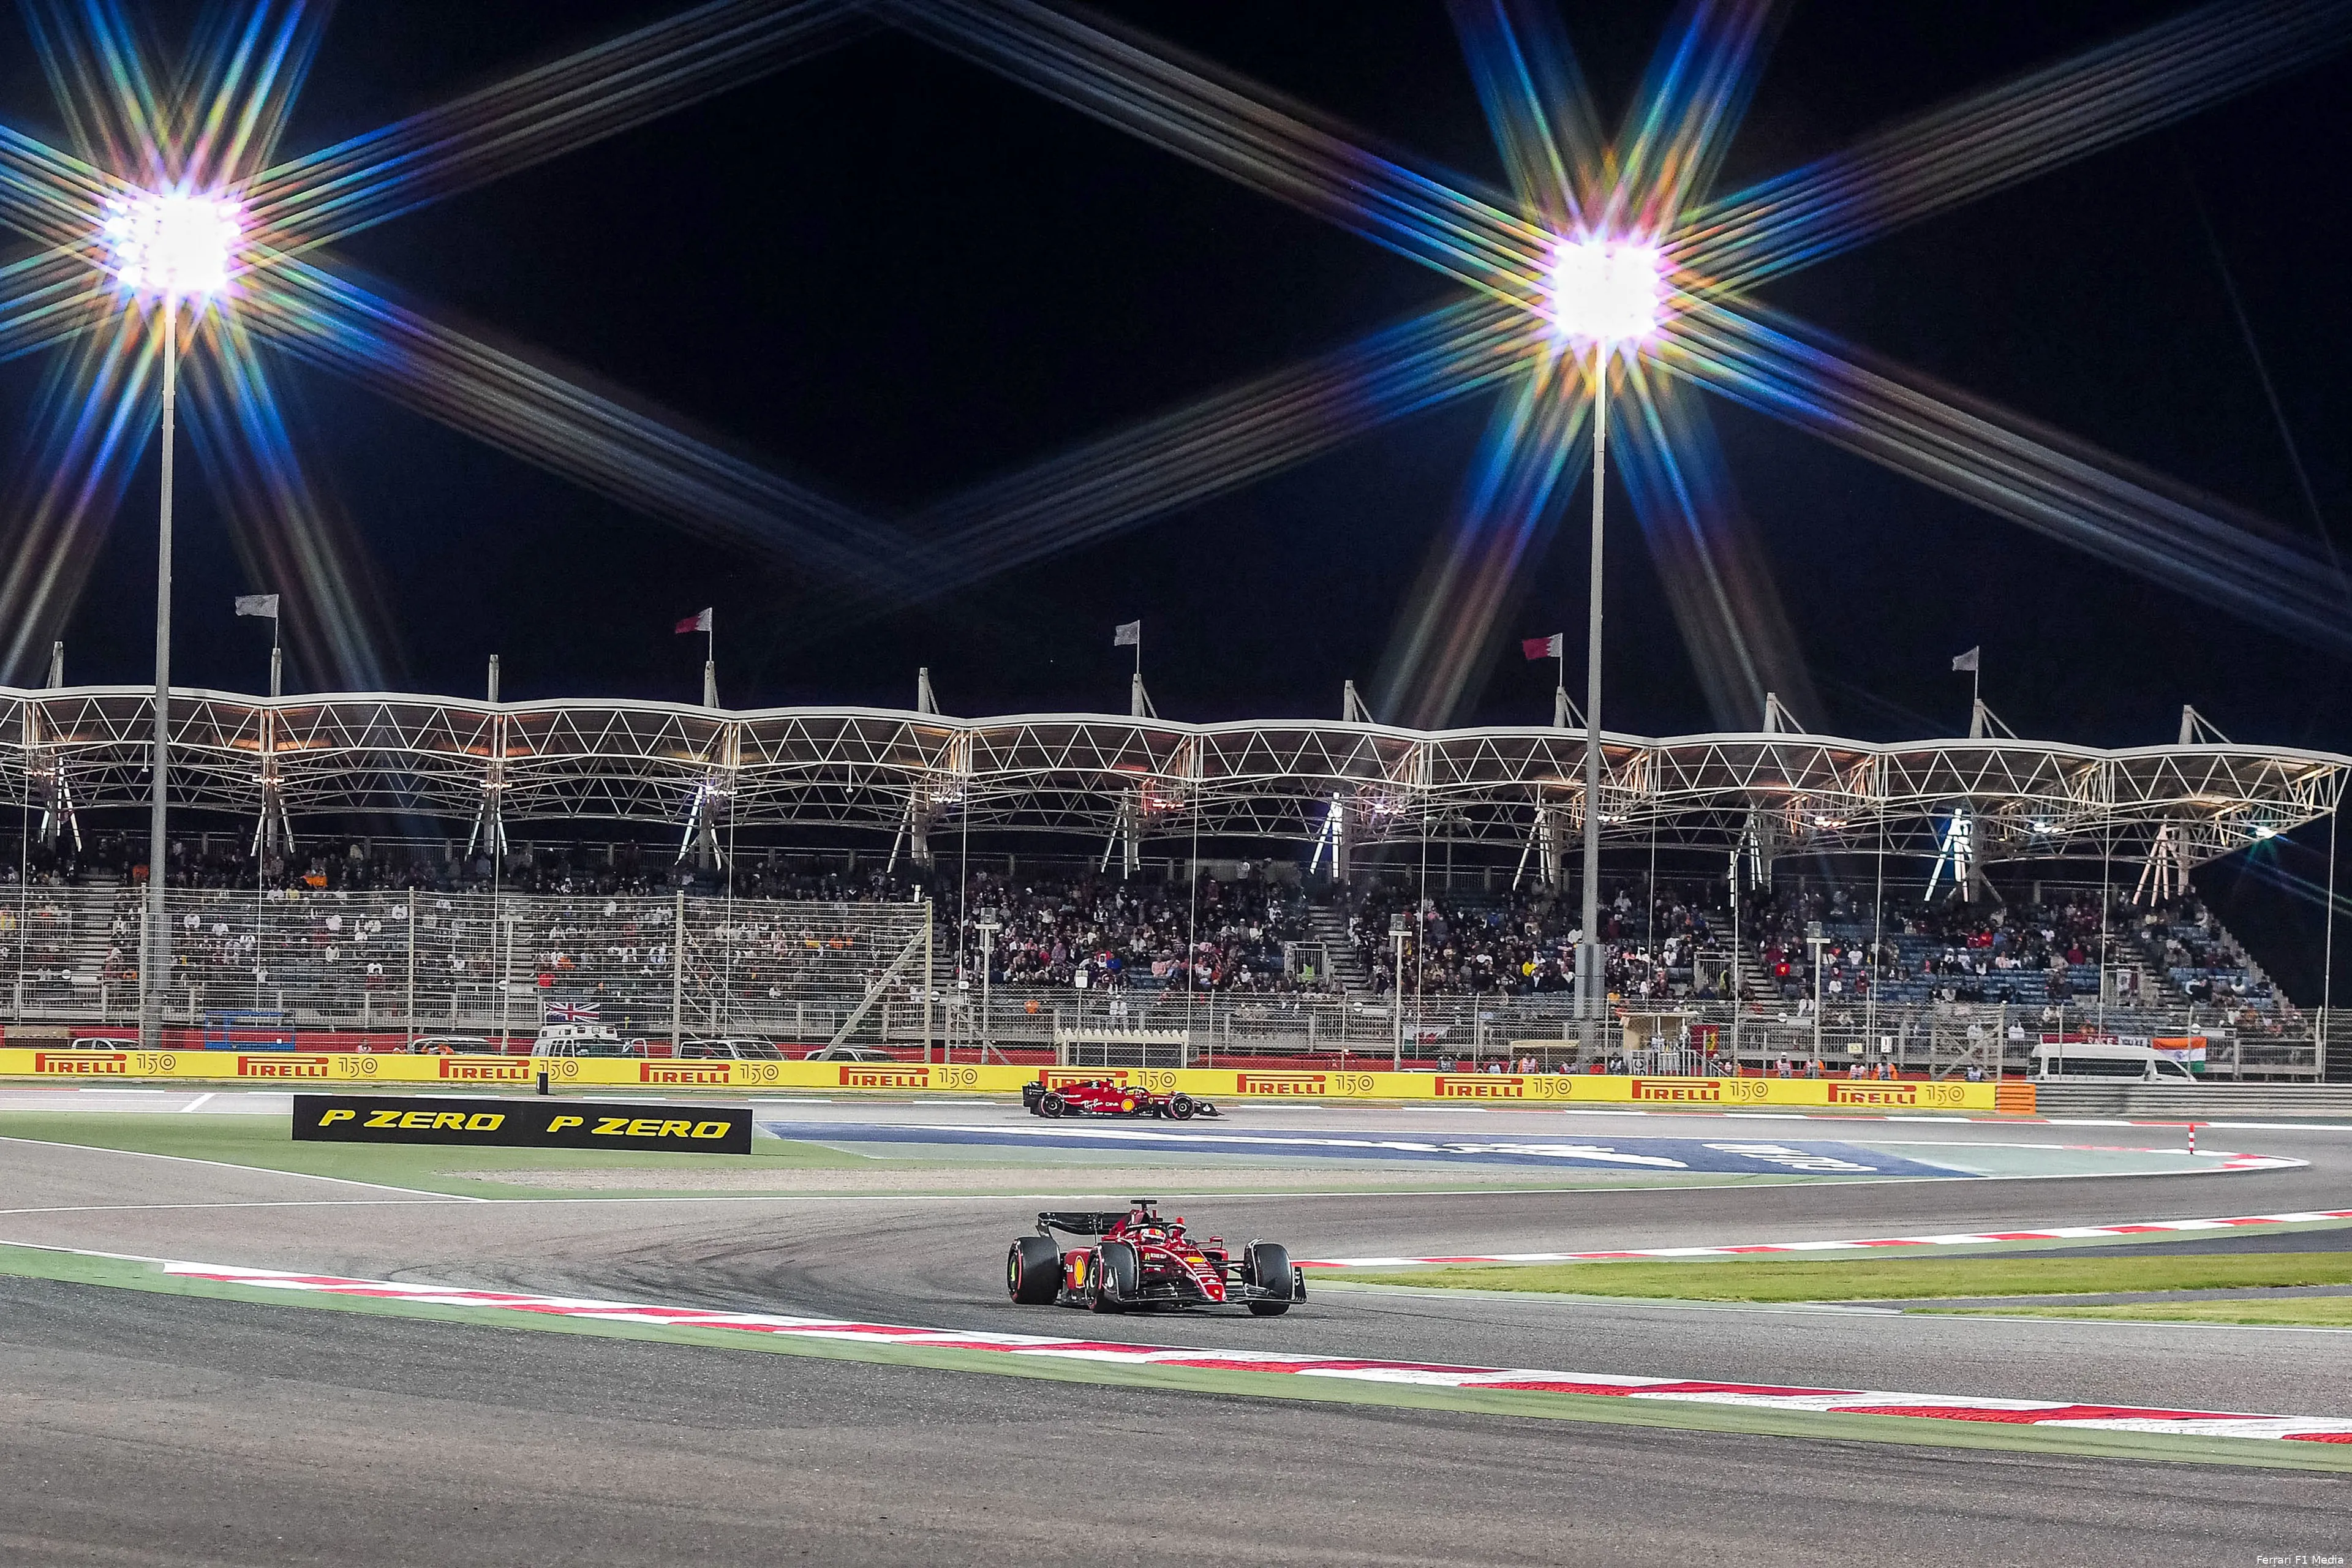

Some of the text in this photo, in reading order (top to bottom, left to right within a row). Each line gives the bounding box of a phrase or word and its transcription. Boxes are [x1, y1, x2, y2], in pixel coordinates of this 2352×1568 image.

[36, 1053, 127, 1072] PIRELLI
[136, 1054, 176, 1074] 150
[238, 1056, 328, 1076] PIRELLI
[338, 1057, 378, 1078] 150
[440, 1058, 529, 1079] PIRELLI
[539, 1060, 579, 1080] 150
[640, 1063, 730, 1083] PIRELLI
[739, 1064, 779, 1084] 150
[840, 1066, 929, 1087] PIRELLI
[938, 1068, 978, 1088] 150
[1137, 1071, 1177, 1091] 150
[1237, 1074, 1325, 1093] PIRELLI
[1335, 1075, 1374, 1095] 150
[1435, 1077, 1523, 1097] PIRELLI
[1532, 1078, 1572, 1098] 150
[1632, 1080, 1720, 1100] PIRELLI
[1730, 1081, 1768, 1101] 150
[1828, 1084, 1917, 1103] PIRELLI
[1926, 1085, 1965, 1106] 150
[319, 1110, 505, 1131] P ZERO
[547, 1117, 731, 1138] P ZERO
